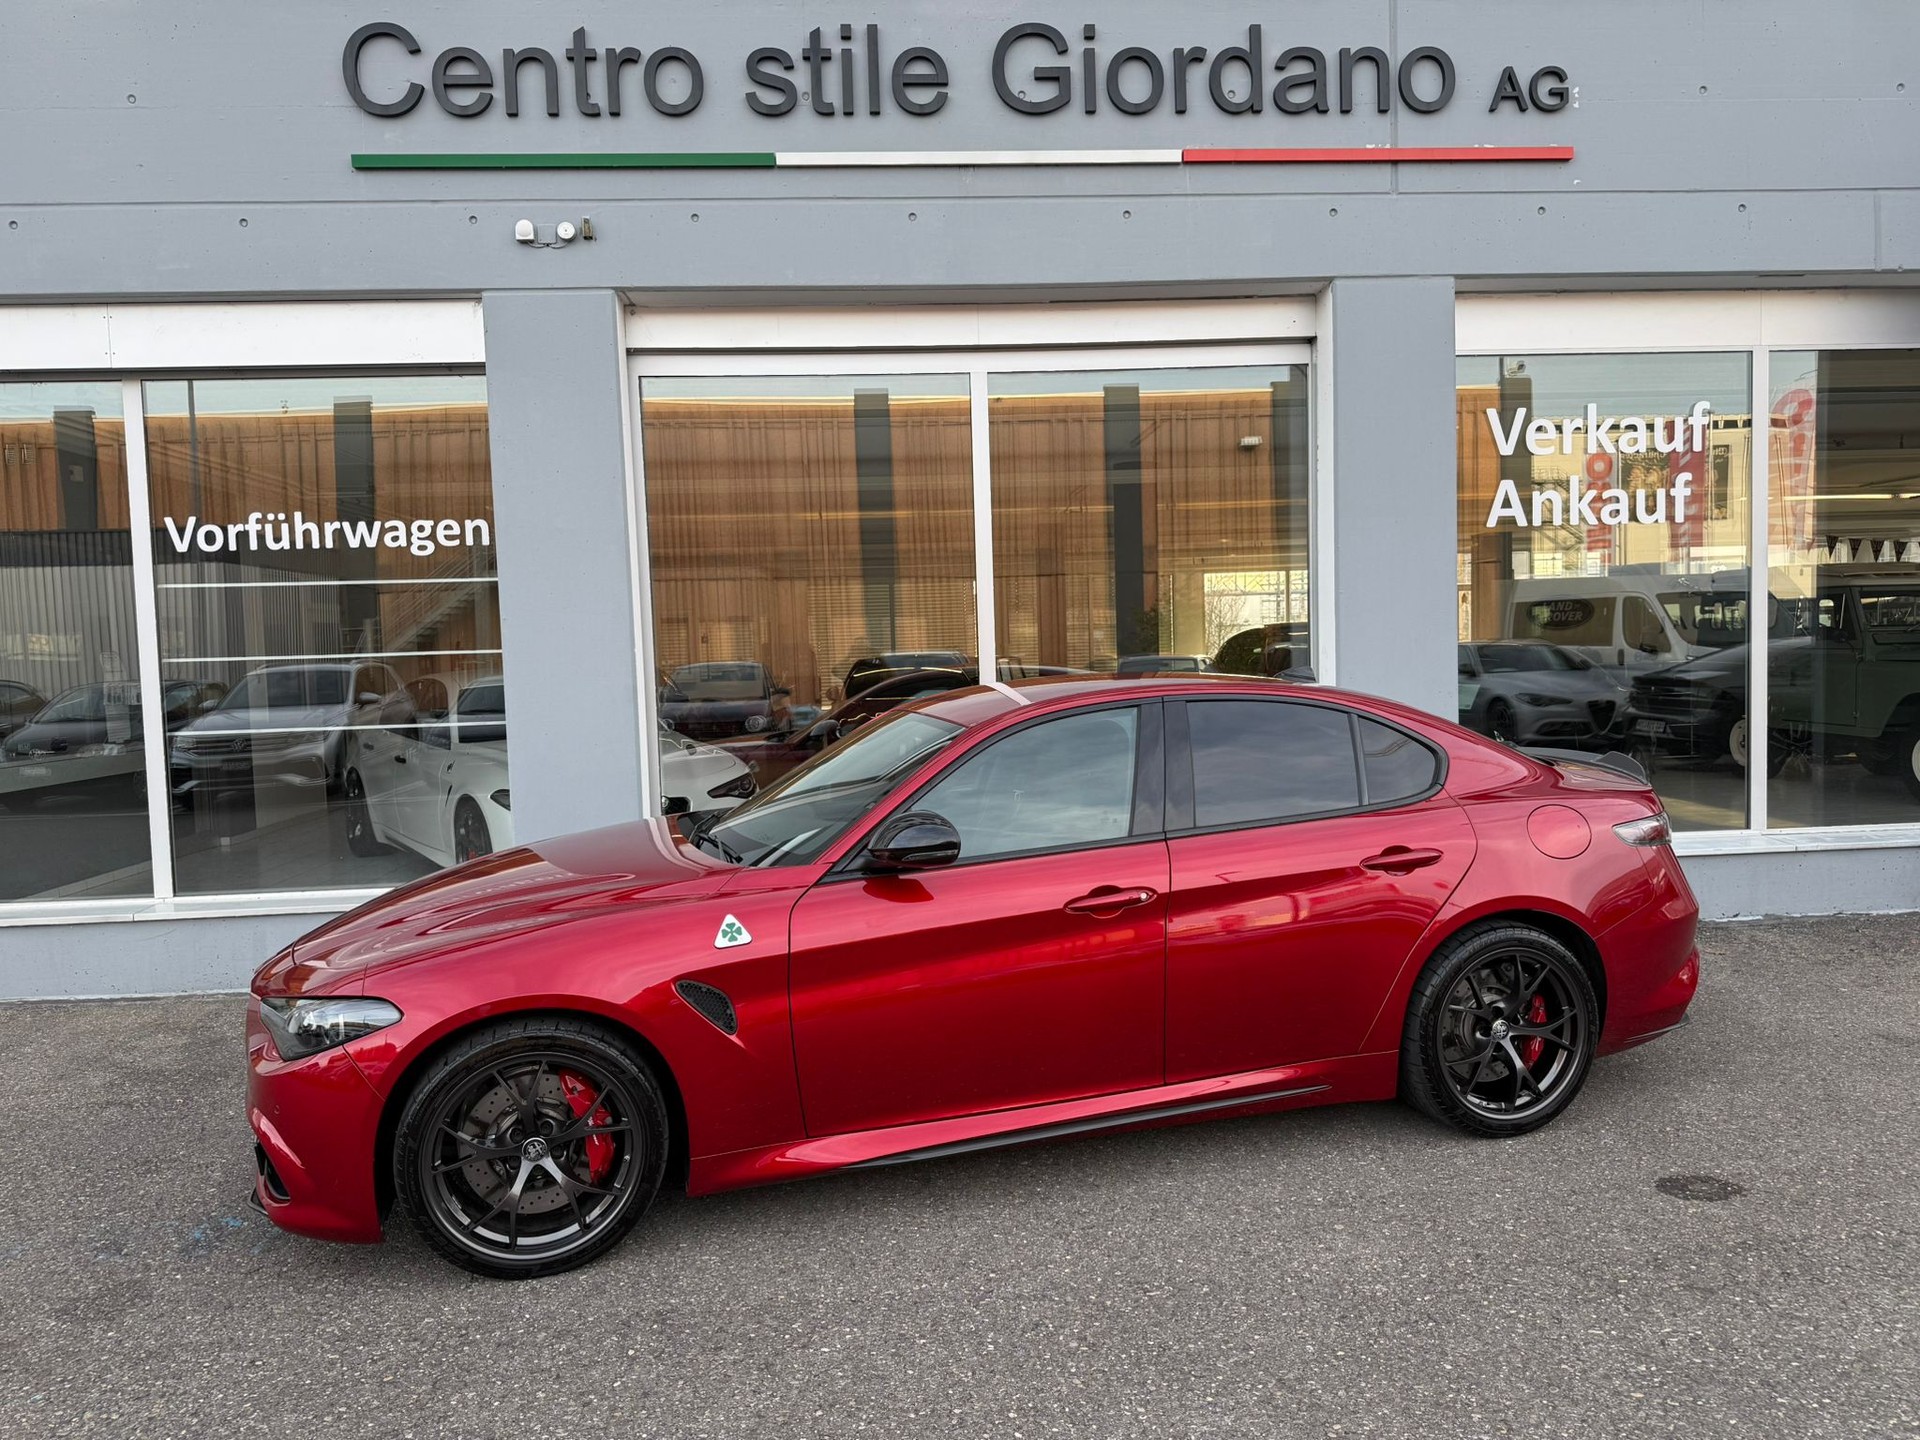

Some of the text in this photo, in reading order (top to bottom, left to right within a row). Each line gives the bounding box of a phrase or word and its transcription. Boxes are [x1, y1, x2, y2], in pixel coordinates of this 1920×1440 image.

[342, 22, 1569, 118] Centro stile Giordano AG
[1486, 400, 1711, 456] Verkauf
[1486, 472, 1693, 528] Ankauf
[164, 511, 490, 556] Vorführwagen
